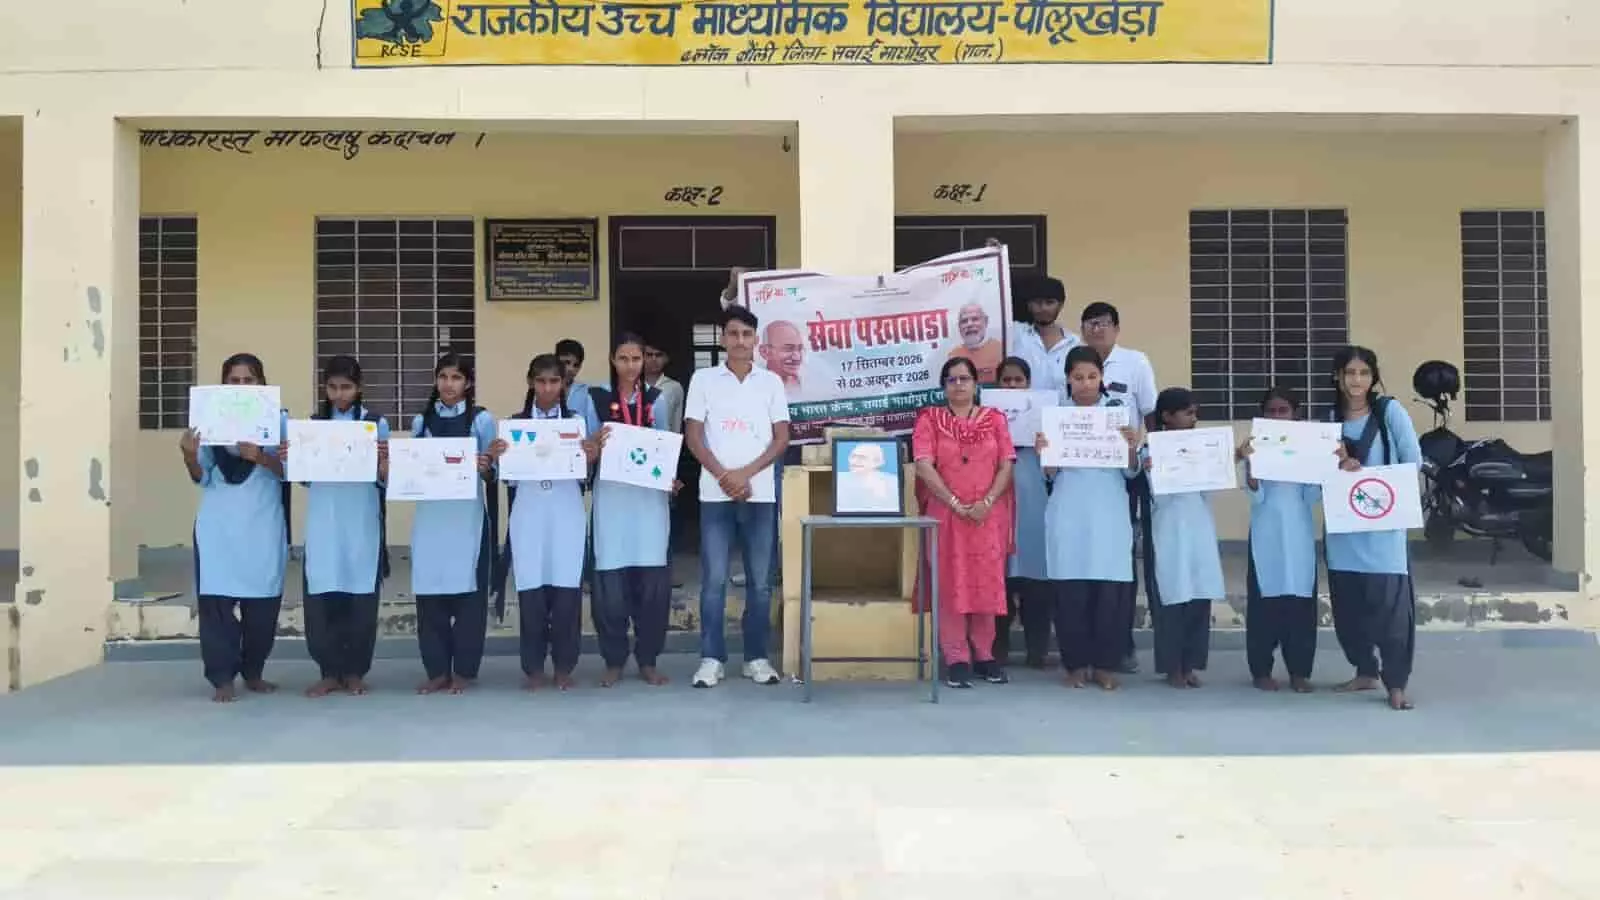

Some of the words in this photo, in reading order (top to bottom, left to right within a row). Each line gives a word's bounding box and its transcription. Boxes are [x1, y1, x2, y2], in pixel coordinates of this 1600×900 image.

[596, 3, 681, 37] उच्च
[381, 44, 421, 57] RCSE
[807, 310, 852, 352] सेवा
[855, 308, 950, 350] पखवाड़ा
[841, 360, 853, 373] 17
[836, 376, 847, 389] से
[849, 378, 863, 388] 02
